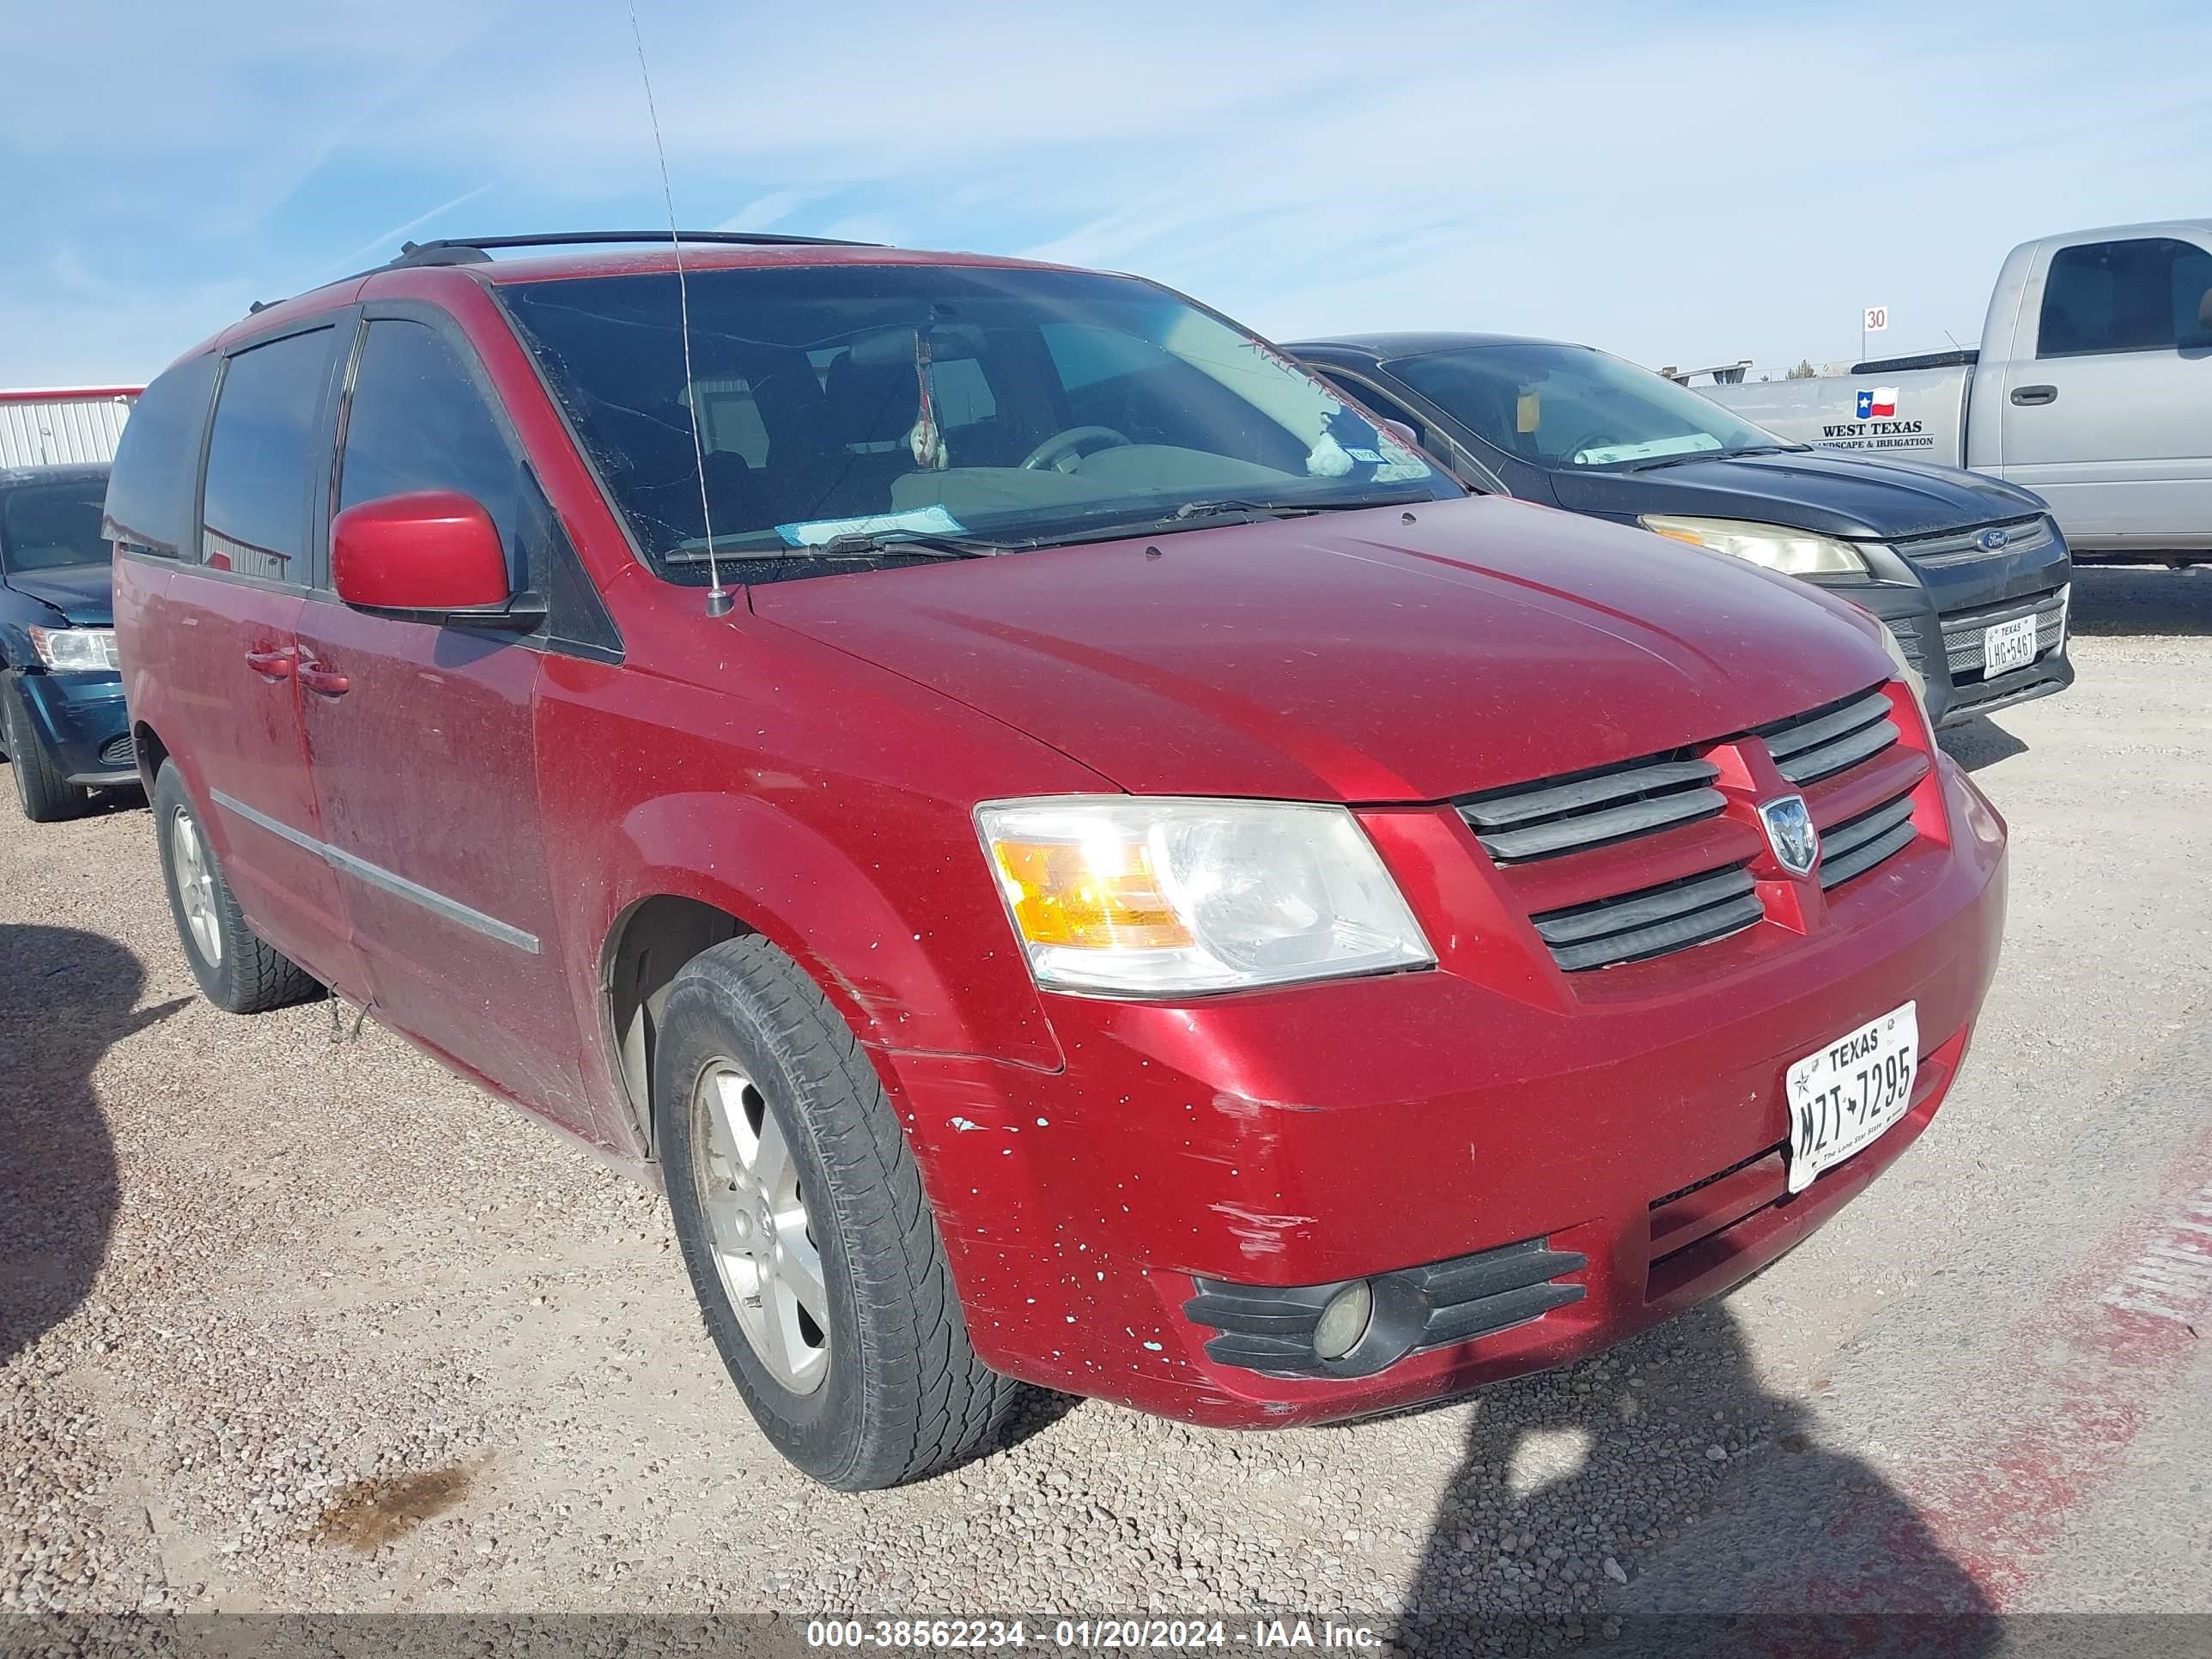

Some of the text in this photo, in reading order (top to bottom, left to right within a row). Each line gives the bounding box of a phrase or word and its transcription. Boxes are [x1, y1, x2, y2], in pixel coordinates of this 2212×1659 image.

[1868, 309, 1885, 328] 30
[1822, 420, 1923, 437] WEST TEXAS
[1876, 437, 1934, 447] IRRIGATION
[1988, 532, 2005, 547] Ford
[2001, 623, 2021, 637] TEXAS
[1829, 1028, 1879, 1072] TEXAS
[1823, 1121, 1883, 1160] The Lone Star State
